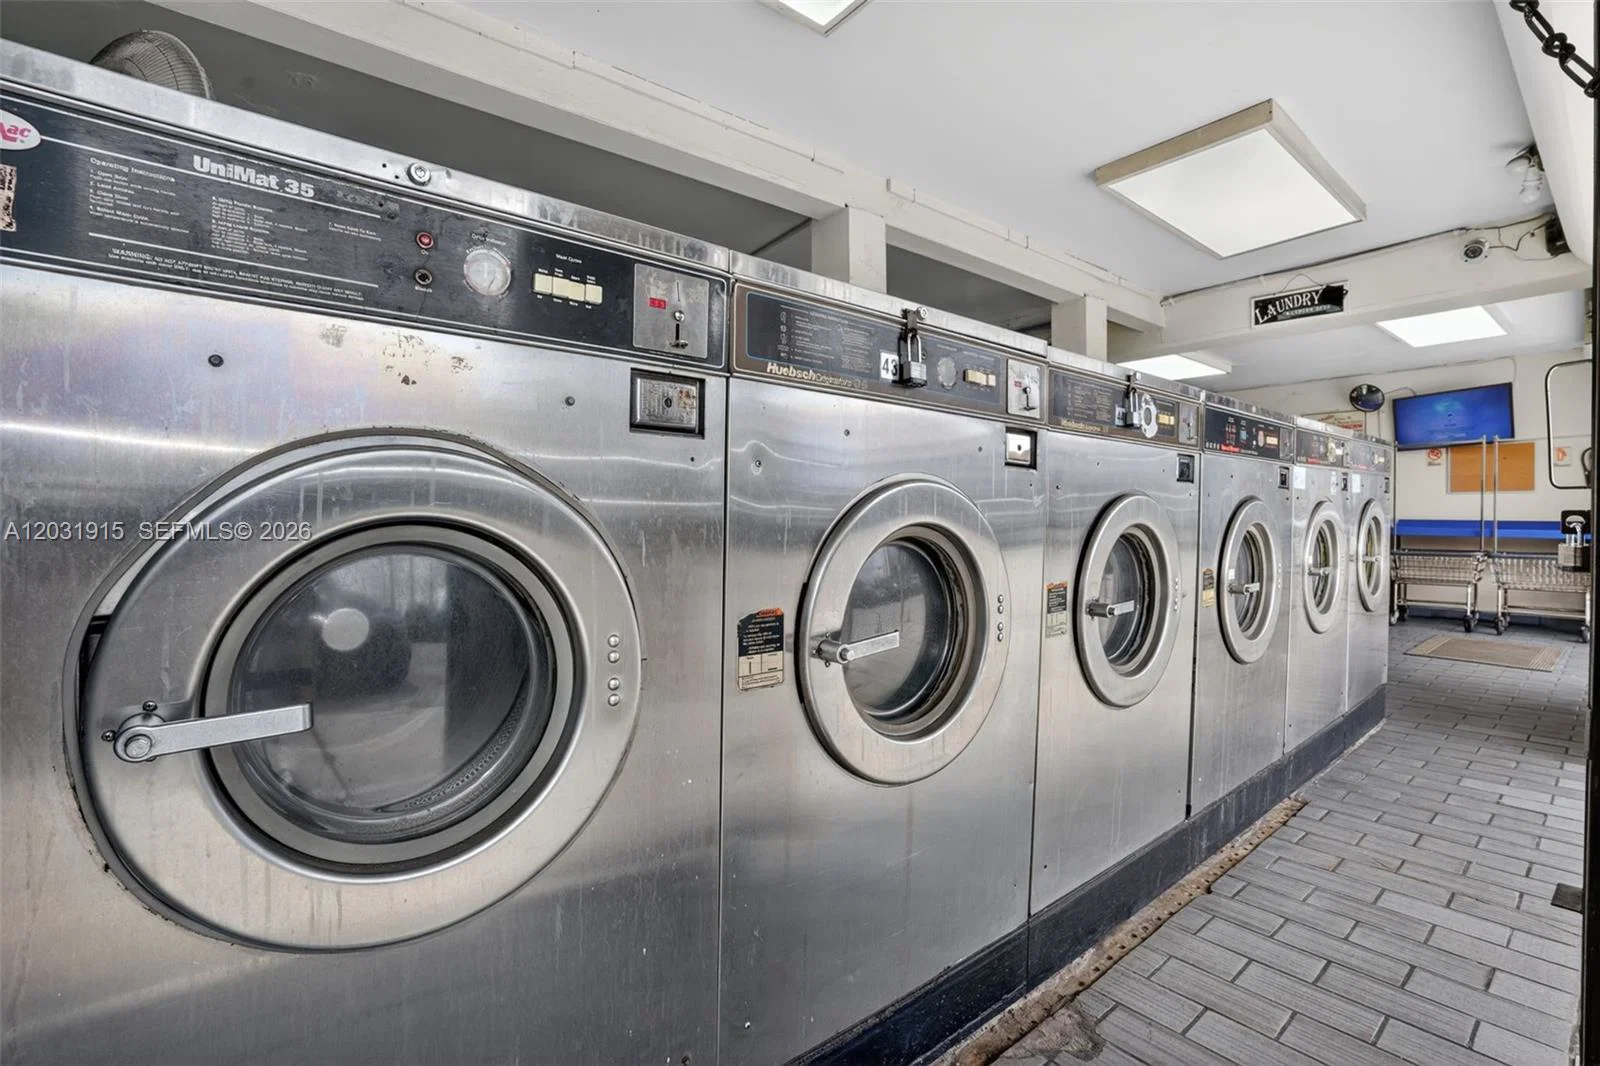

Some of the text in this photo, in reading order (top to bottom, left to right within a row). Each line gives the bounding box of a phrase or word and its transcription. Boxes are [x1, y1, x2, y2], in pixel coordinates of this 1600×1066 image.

[90, 157, 129, 173] Operating
[193, 154, 279, 189] UniMat
[284, 178, 314, 198] 35
[1255, 286, 1324, 324] LAUNDRY
[766, 362, 816, 380] Huebsch
[882, 358, 898, 376] 43
